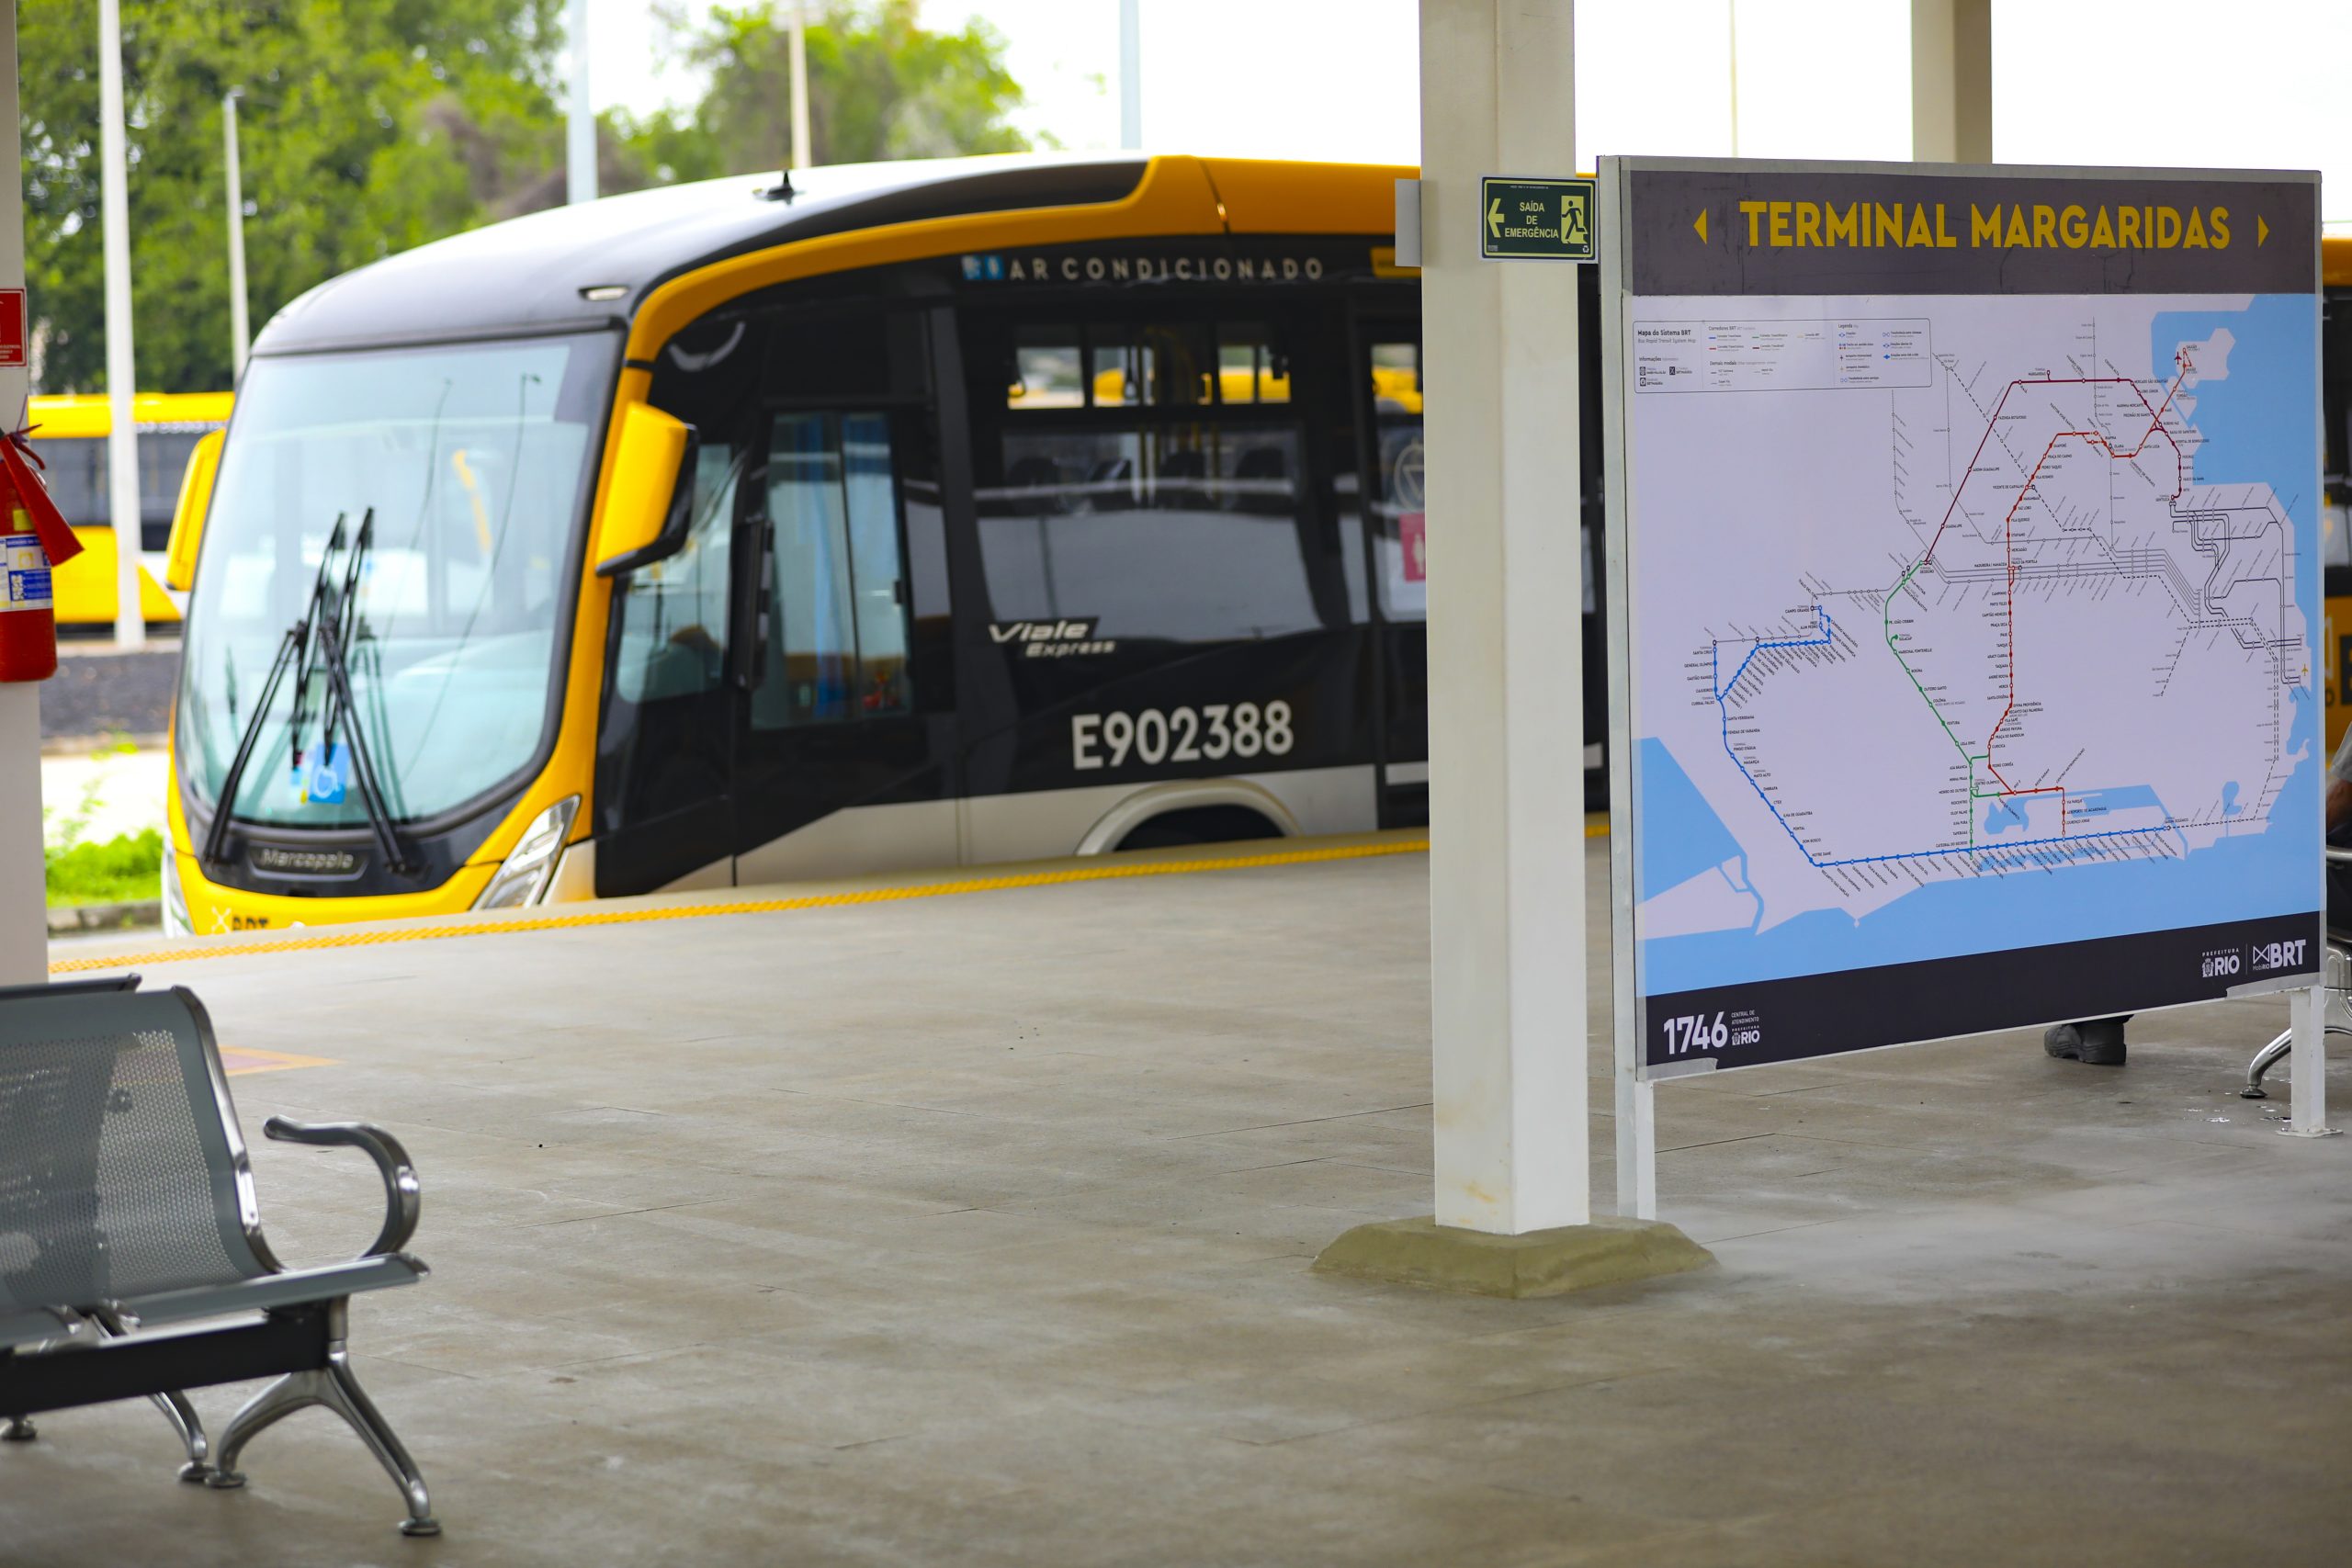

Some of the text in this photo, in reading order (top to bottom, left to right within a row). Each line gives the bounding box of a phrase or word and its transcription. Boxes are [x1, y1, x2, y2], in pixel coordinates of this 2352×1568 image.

[1519, 200, 1545, 212] SAÍDA
[1526, 215, 1538, 225] DE
[1739, 201, 2231, 250] TERMINAL MARGARIDAS
[1504, 226, 1559, 239] EMERGÊNCIA
[1010, 257, 1324, 281] AR CONDICIONADO
[988, 620, 1090, 642] Viale
[1025, 640, 1116, 658] Express
[1071, 700, 1295, 770] E902388
[260, 847, 355, 870] Marcopolo
[2201, 947, 2240, 957] PREFEITURA
[2214, 939, 2307, 976] RIO BRT
[1731, 1017, 1759, 1025] ATENDIMENTO
[1663, 1010, 1728, 1055] 1746
[1740, 1030, 1760, 1044] RIO
